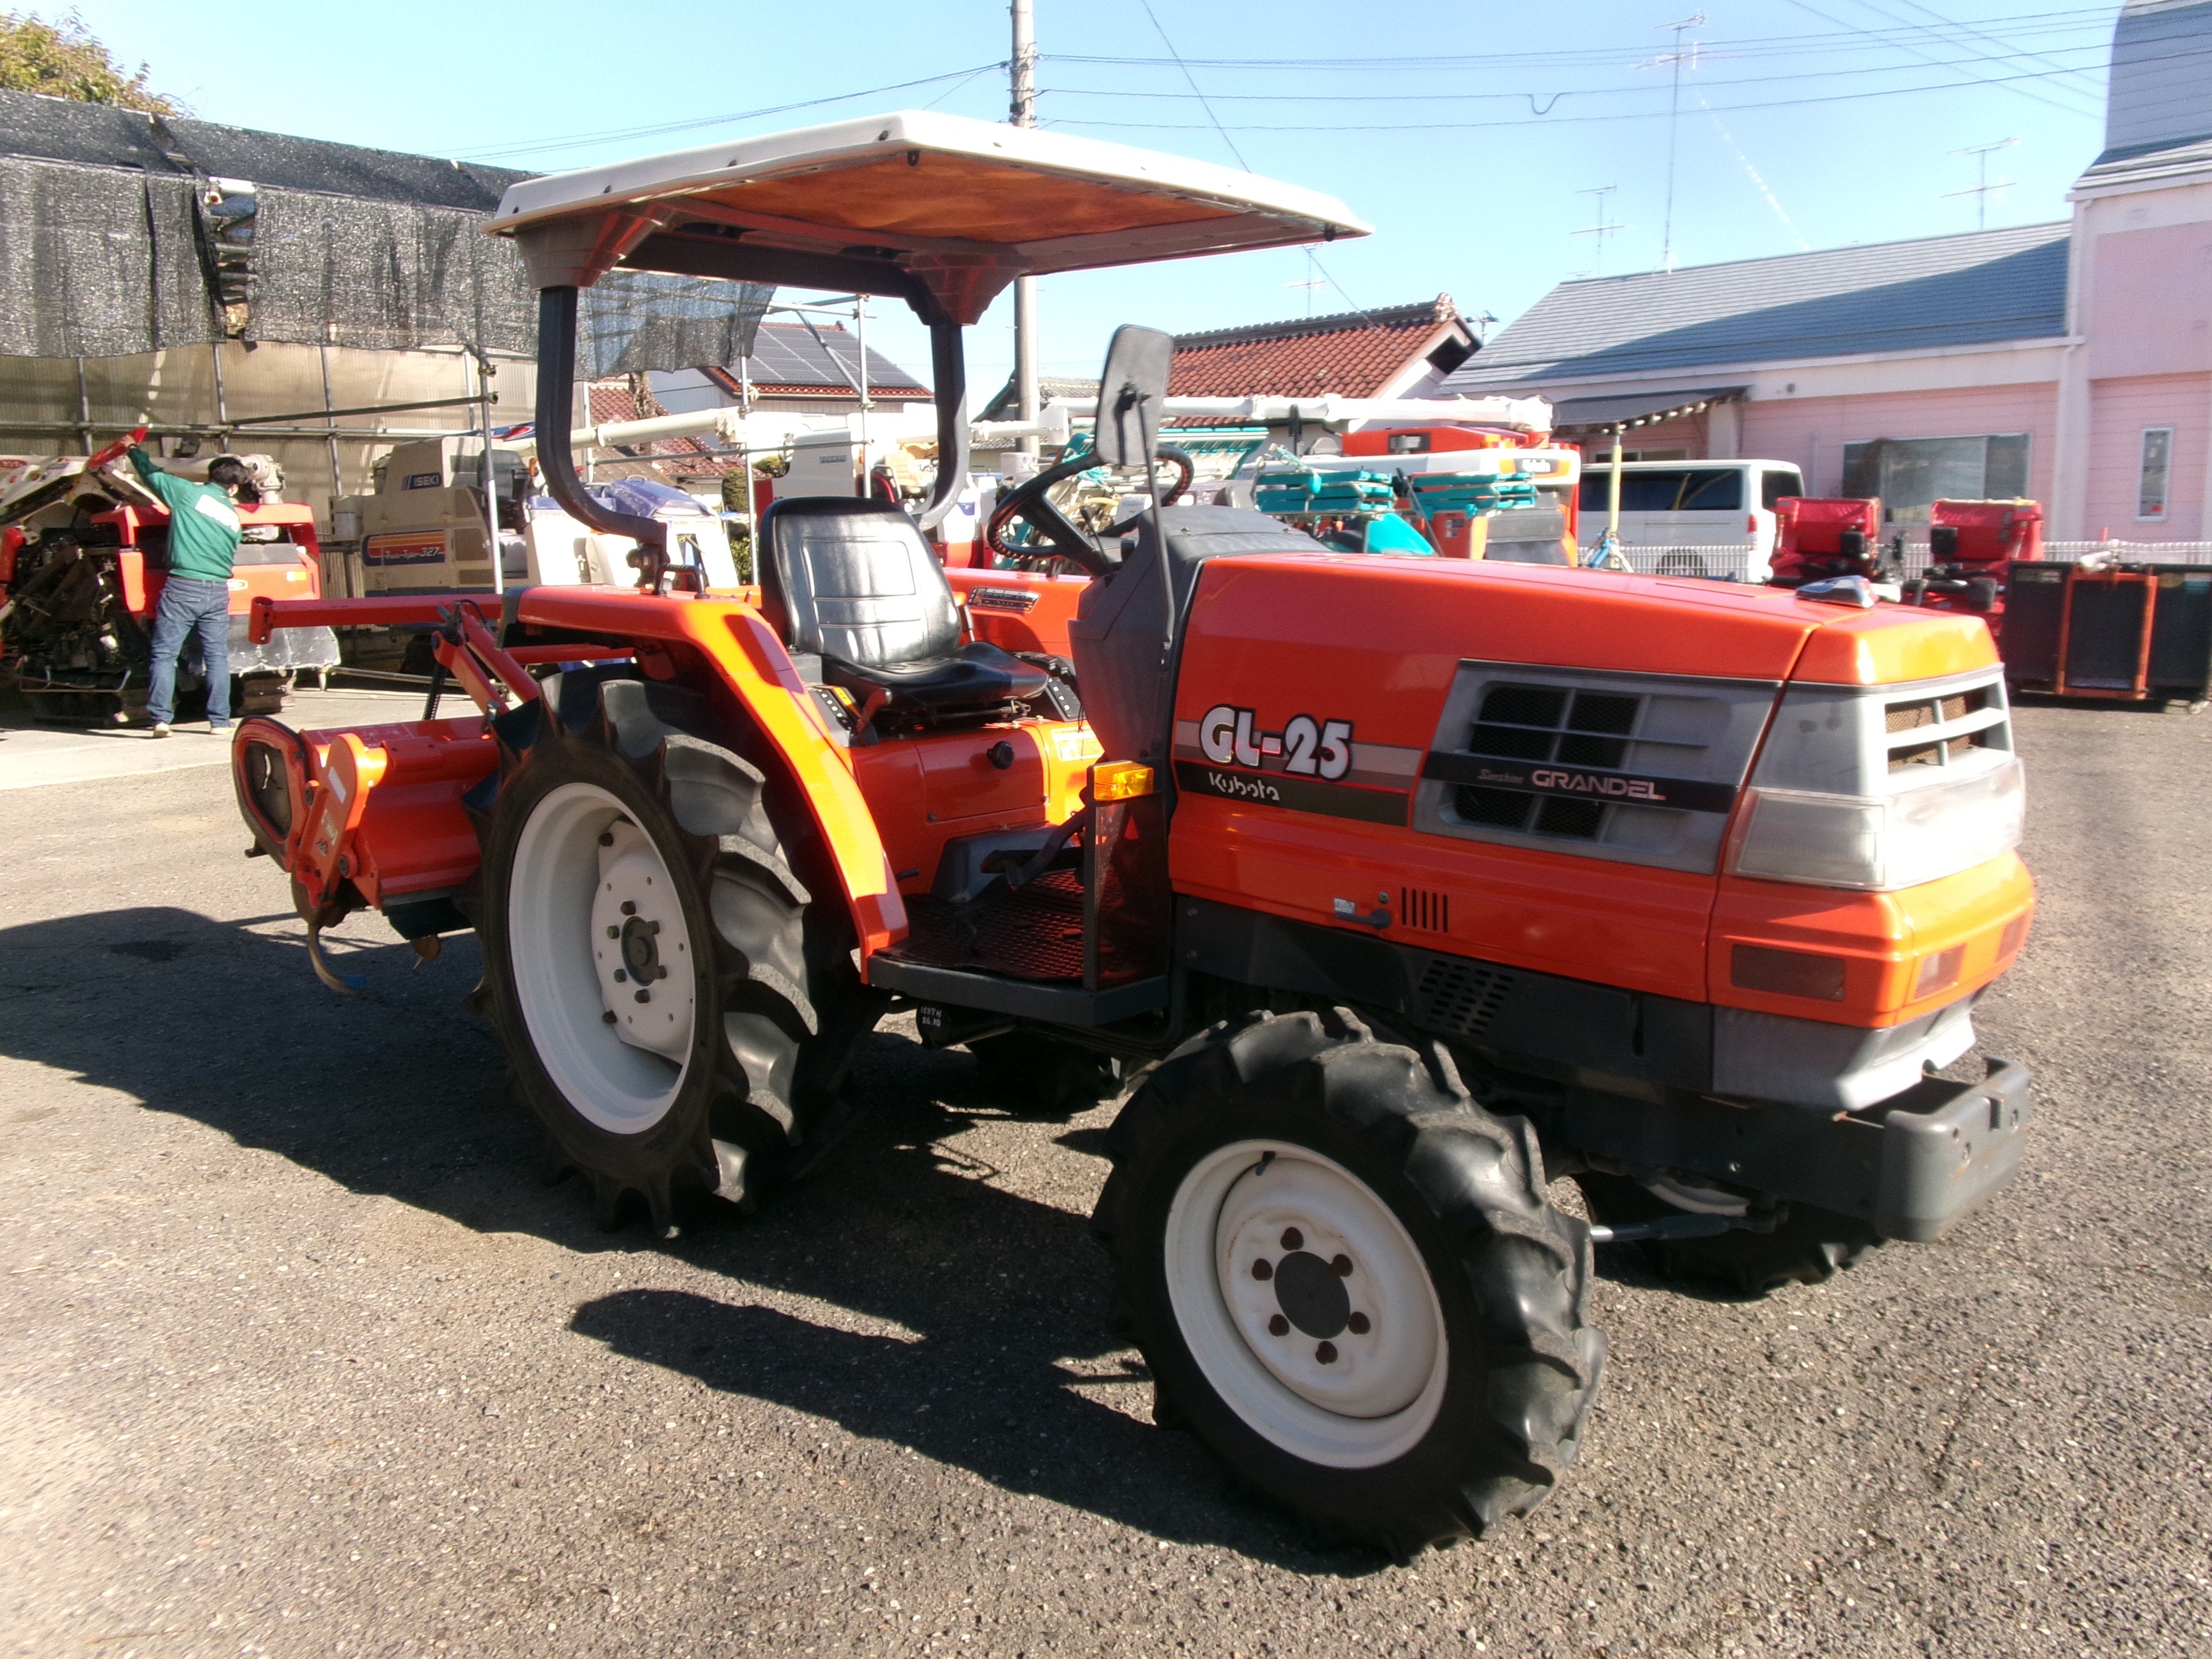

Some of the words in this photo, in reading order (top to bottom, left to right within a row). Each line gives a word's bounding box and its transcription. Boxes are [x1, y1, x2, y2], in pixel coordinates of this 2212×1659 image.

[1200, 706, 1352, 780] GL-25
[1209, 772, 1280, 801] Kubota
[1532, 769, 1667, 801] GRANDEL
